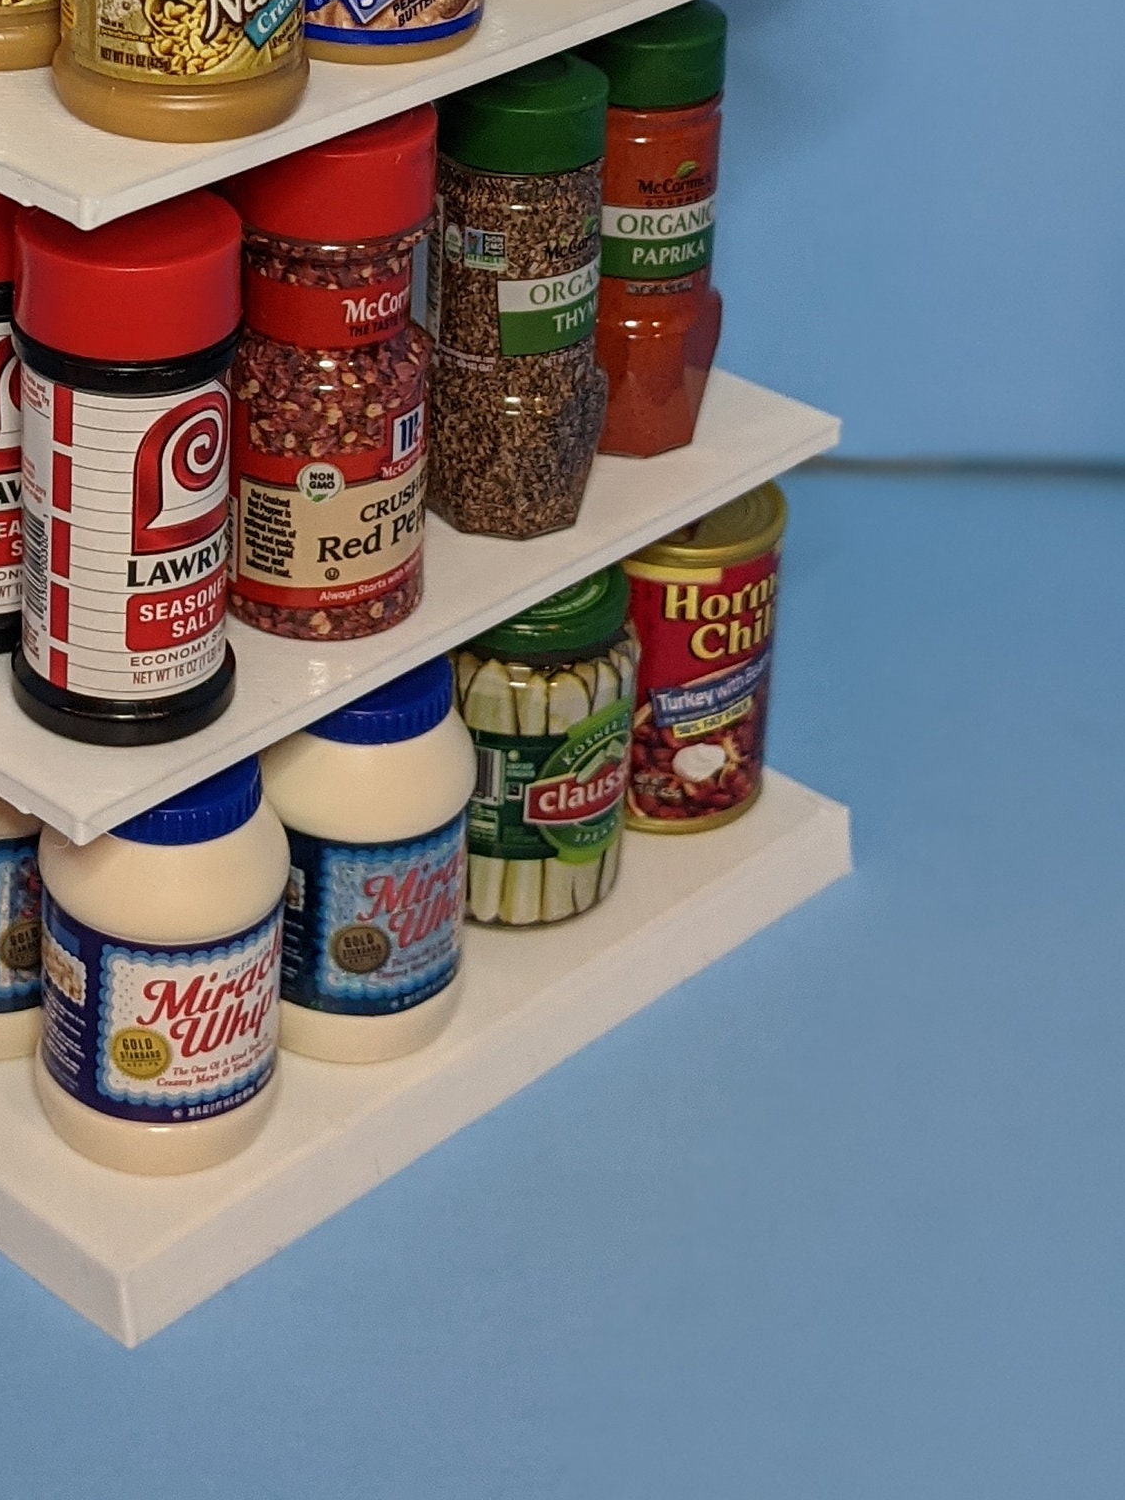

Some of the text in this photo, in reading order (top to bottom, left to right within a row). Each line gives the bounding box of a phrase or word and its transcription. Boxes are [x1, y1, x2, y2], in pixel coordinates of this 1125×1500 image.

[617, 200, 714, 236] ORGANIC
[632, 238, 705, 265] PAPRIKA
[349, 318, 398, 337] THE TASTE
[309, 472, 334, 480] NON
[309, 481, 335, 489] GMO
[317, 523, 383, 563] Red
[319, 578, 387, 602] Always Starts
[172, 603, 217, 639] SALT
[130, 638, 208, 667] ECONOMY
[133, 671, 153, 685] NET
[155, 669, 171, 682] WT
[186, 658, 197, 674] OZ
[656, 688, 714, 712] Turkey
[343, 933, 374, 948] GOLD
[169, 984, 275, 1058] Whip
[120, 1050, 162, 1060] STANDARD
[122, 1037, 153, 1051] GOLD
[156, 1072, 219, 1086] Creamy Mayo
[172, 1060, 220, 1076] The One Of
